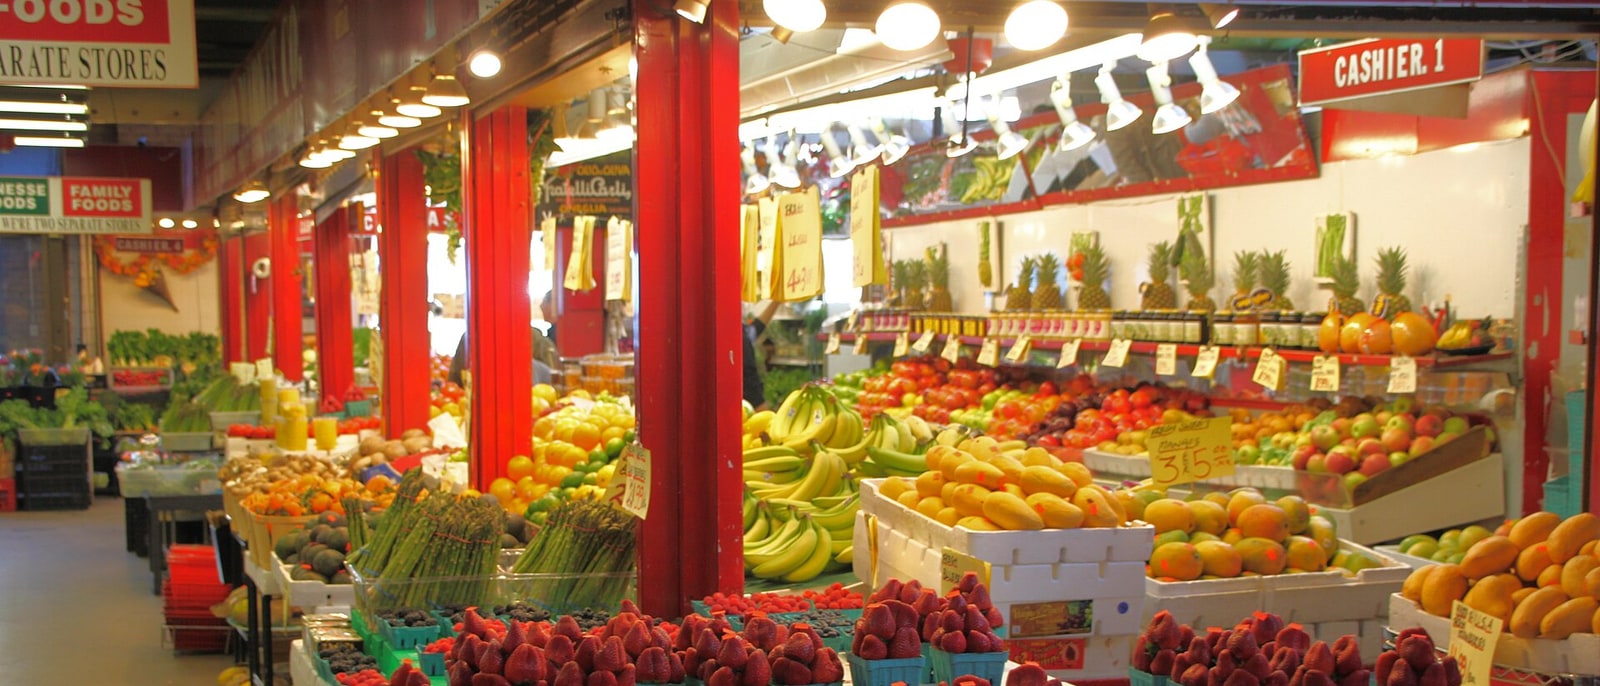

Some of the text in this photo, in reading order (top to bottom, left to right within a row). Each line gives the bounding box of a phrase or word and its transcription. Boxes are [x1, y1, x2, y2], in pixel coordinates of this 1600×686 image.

[0, 0, 144, 26] OODS
[79, 48, 167, 81] STORES
[1434, 38, 1444, 72] 1
[70, 185, 132, 199] FAMILY
[0, 197, 37, 210] ODS
[72, 198, 133, 212] FOODS
[2, 217, 141, 232] WE'RE TWO SEPARATE STORES
[1157, 455, 1179, 483] 3
[1194, 448, 1211, 478] 5
